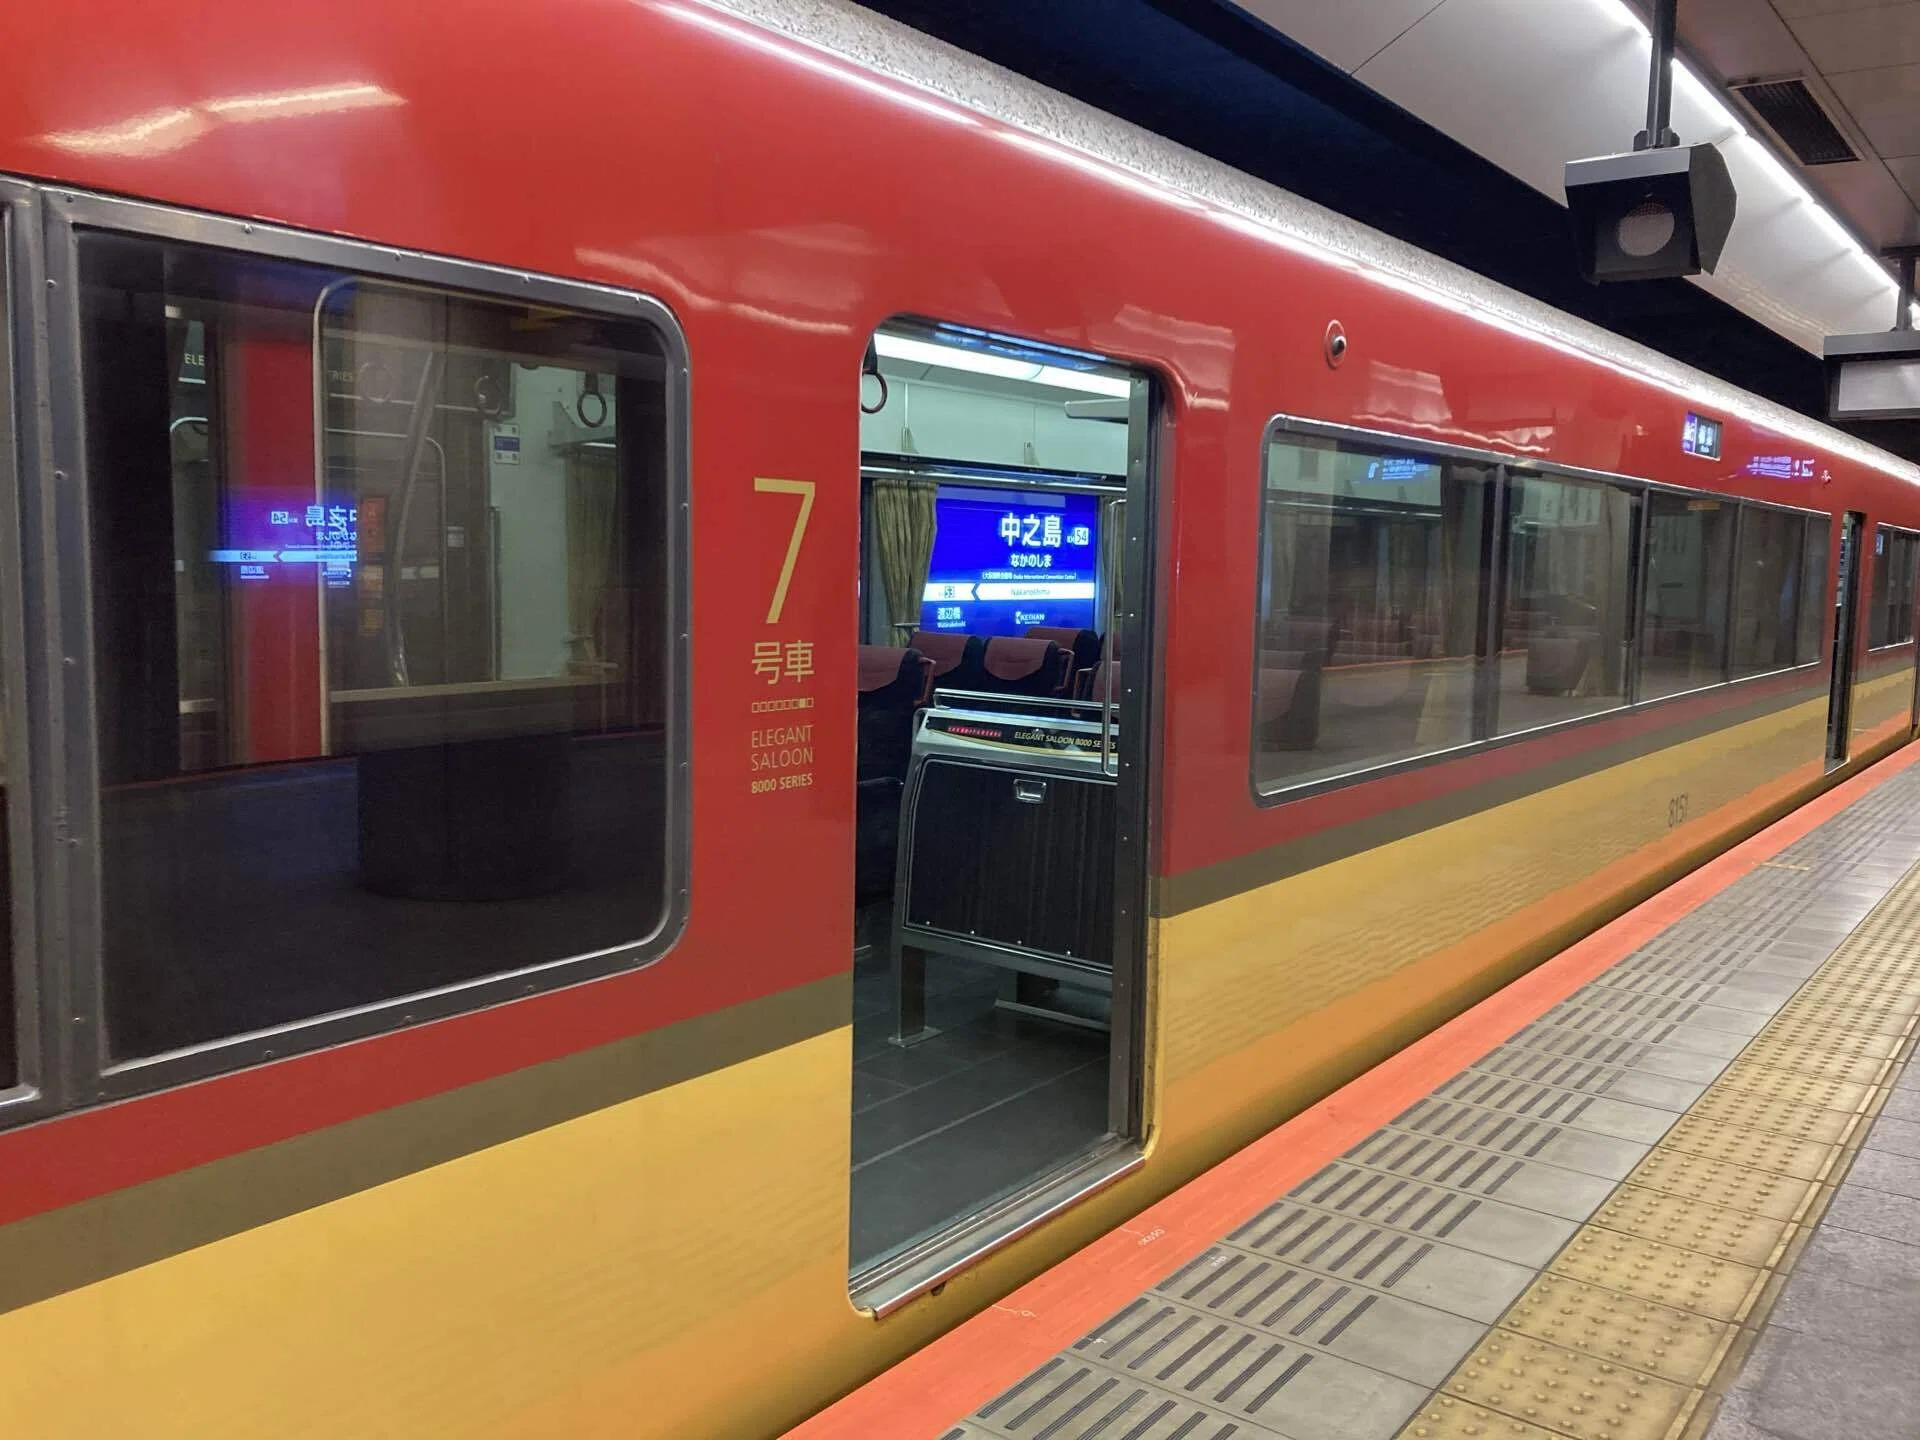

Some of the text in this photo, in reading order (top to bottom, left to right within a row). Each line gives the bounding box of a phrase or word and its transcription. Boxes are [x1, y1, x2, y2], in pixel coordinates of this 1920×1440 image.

[1001, 513, 1062, 547] 中之島
[754, 477, 815, 624] 7
[1010, 554, 1051, 568] なかのしま
[752, 640, 814, 685] 号車
[752, 725, 814, 748] ELEGANT
[1014, 731, 1044, 741] ELEGANT
[752, 747, 813, 771] SALOON
[752, 773, 813, 794] 8000 SERIES
